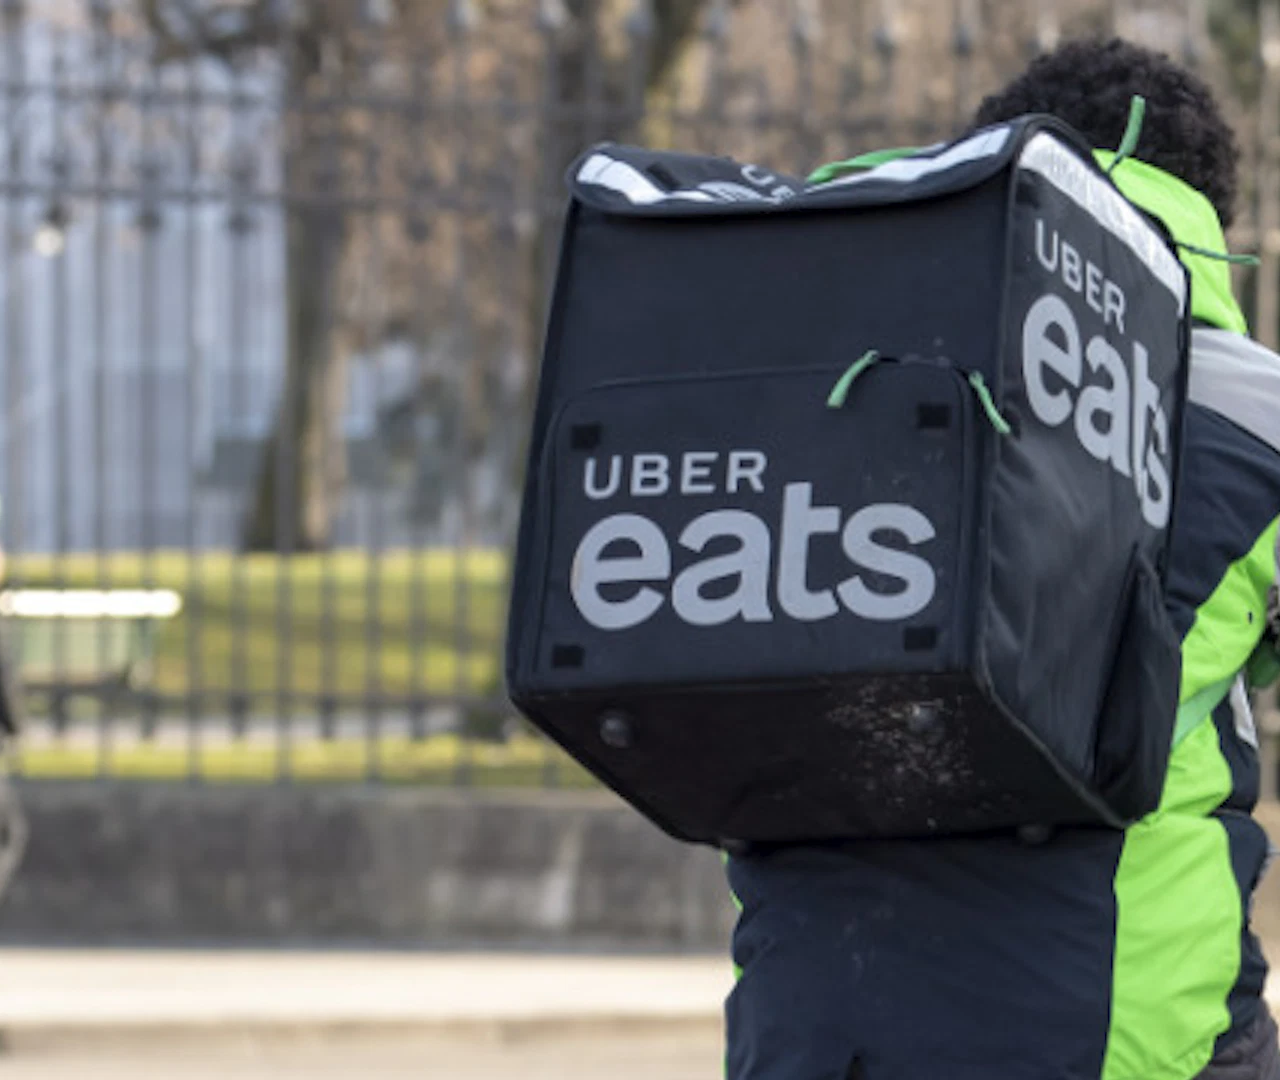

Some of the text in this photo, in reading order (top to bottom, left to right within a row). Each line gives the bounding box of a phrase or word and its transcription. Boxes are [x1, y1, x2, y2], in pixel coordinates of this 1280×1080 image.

[1034, 217, 1127, 335] UBER
[583, 450, 768, 500] UBER
[1022, 293, 1170, 529] eats
[570, 481, 937, 630] eats
